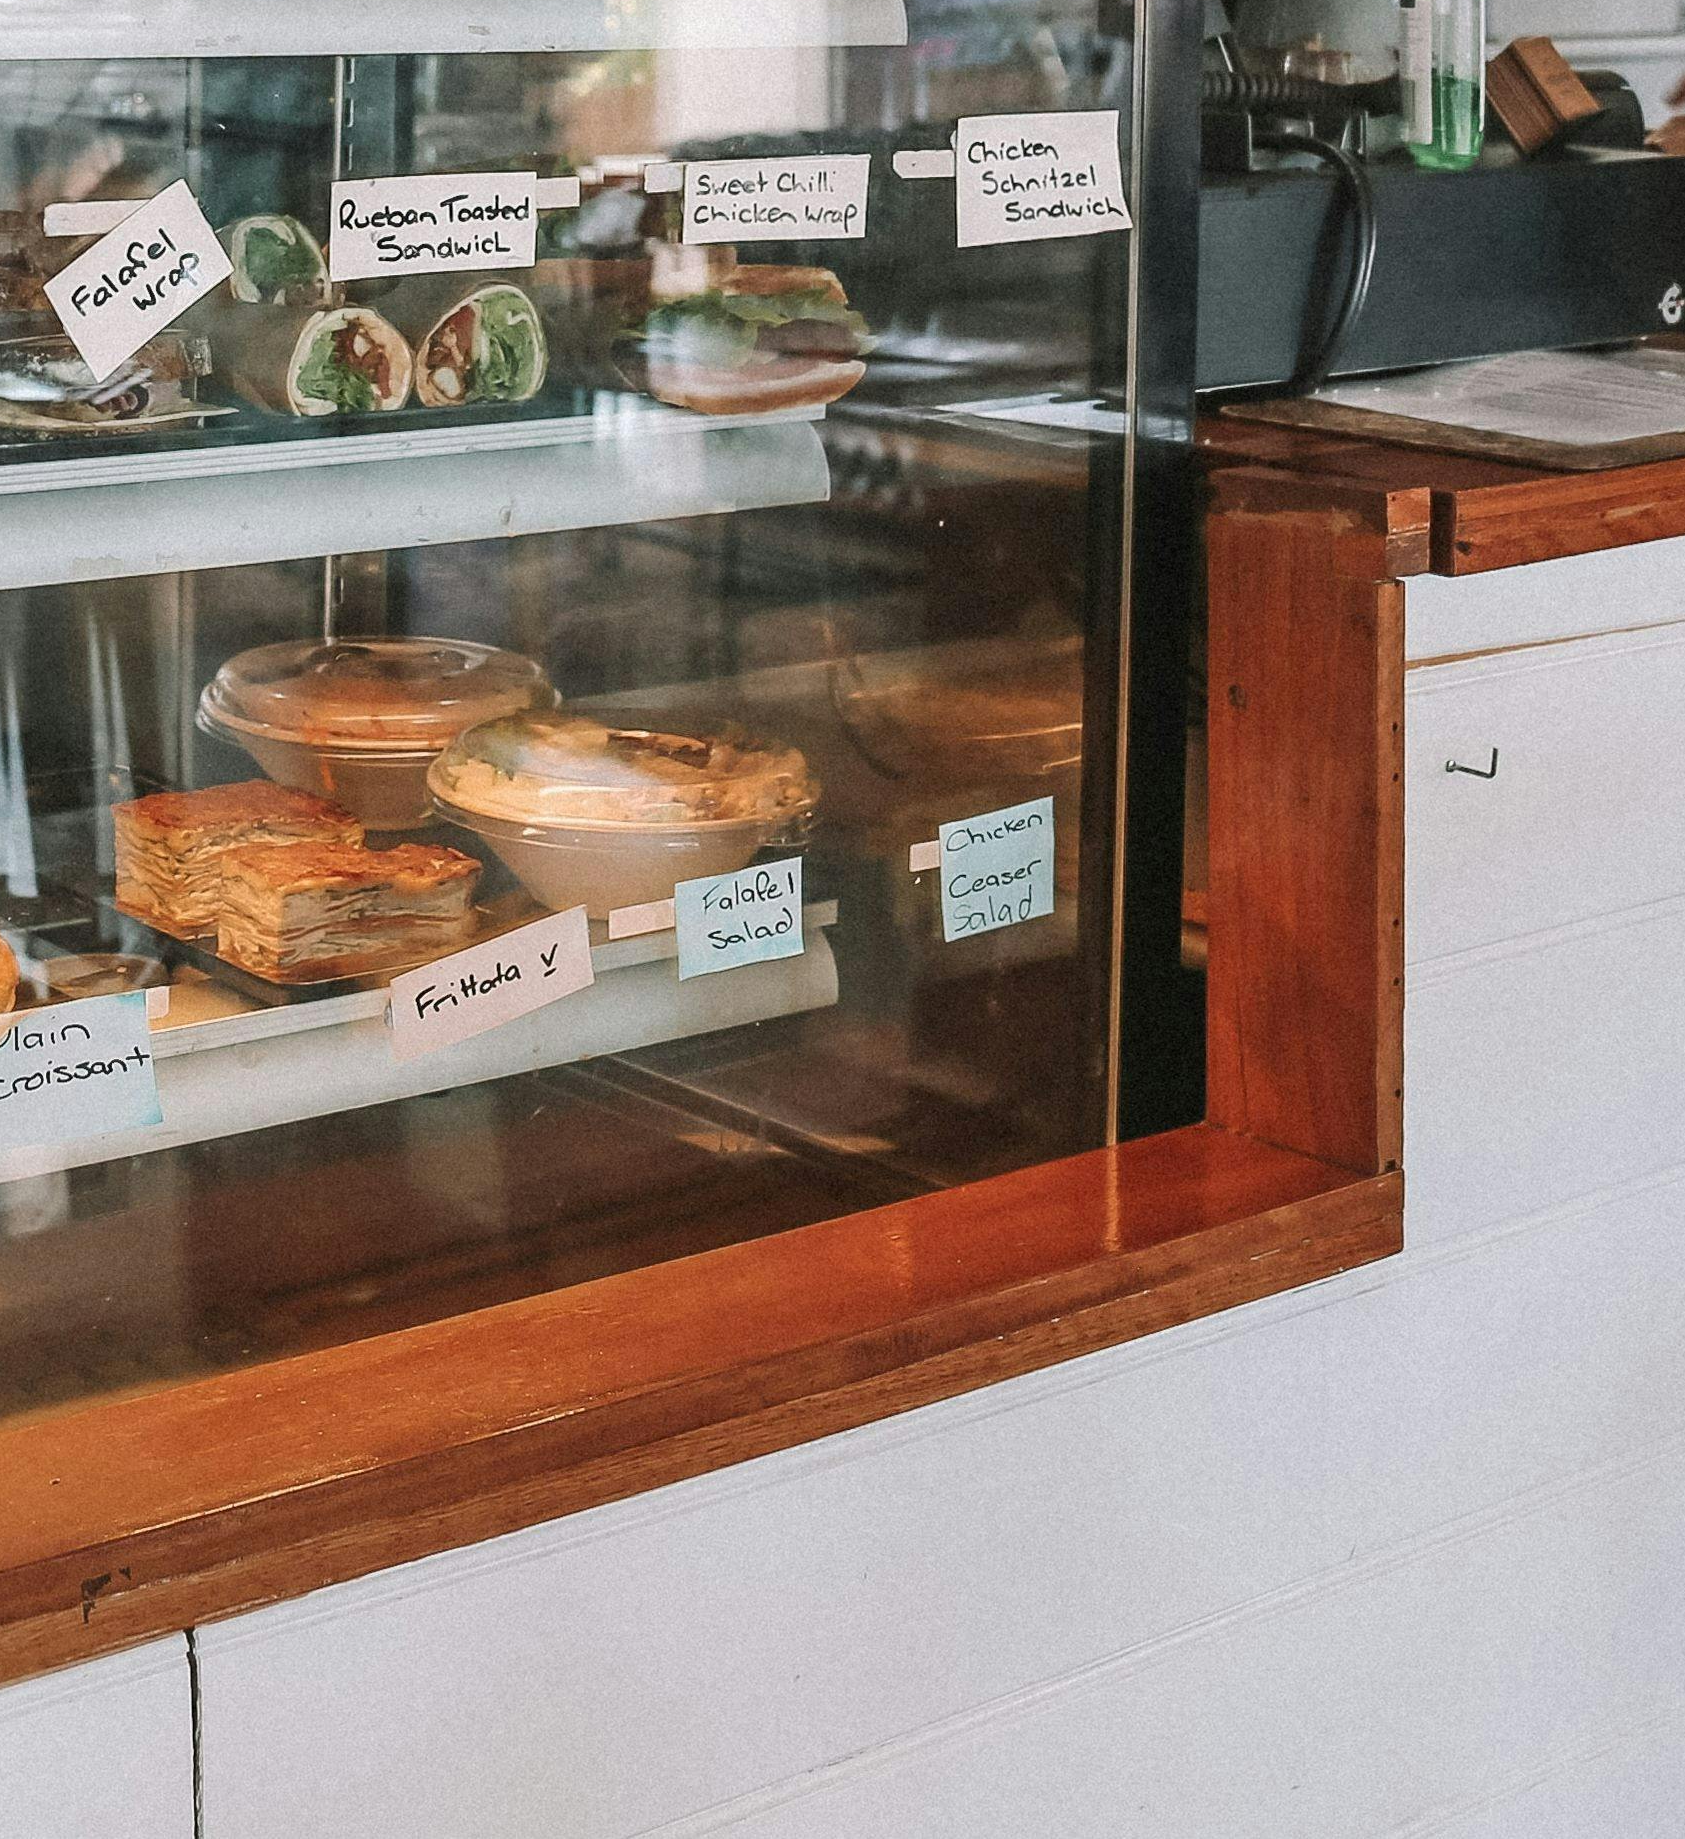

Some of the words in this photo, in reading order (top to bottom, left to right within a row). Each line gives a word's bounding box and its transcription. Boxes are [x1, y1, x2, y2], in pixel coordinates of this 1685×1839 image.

[968, 140, 1059, 164] Chicken
[696, 175, 768, 197] Sweet
[982, 171, 1097, 196] Schnitzel
[339, 198, 438, 230] Rueban
[440, 194, 531, 225] Toasted
[693, 203, 798, 225] Chicken
[1005, 196, 1124, 223] Sandwich
[71, 227, 177, 317] Falafel
[946, 814, 1043, 852] Chicken
[702, 871, 794, 915] Falafel
[949, 859, 1042, 898] Ceaser
[953, 884, 1032, 932] Salad
